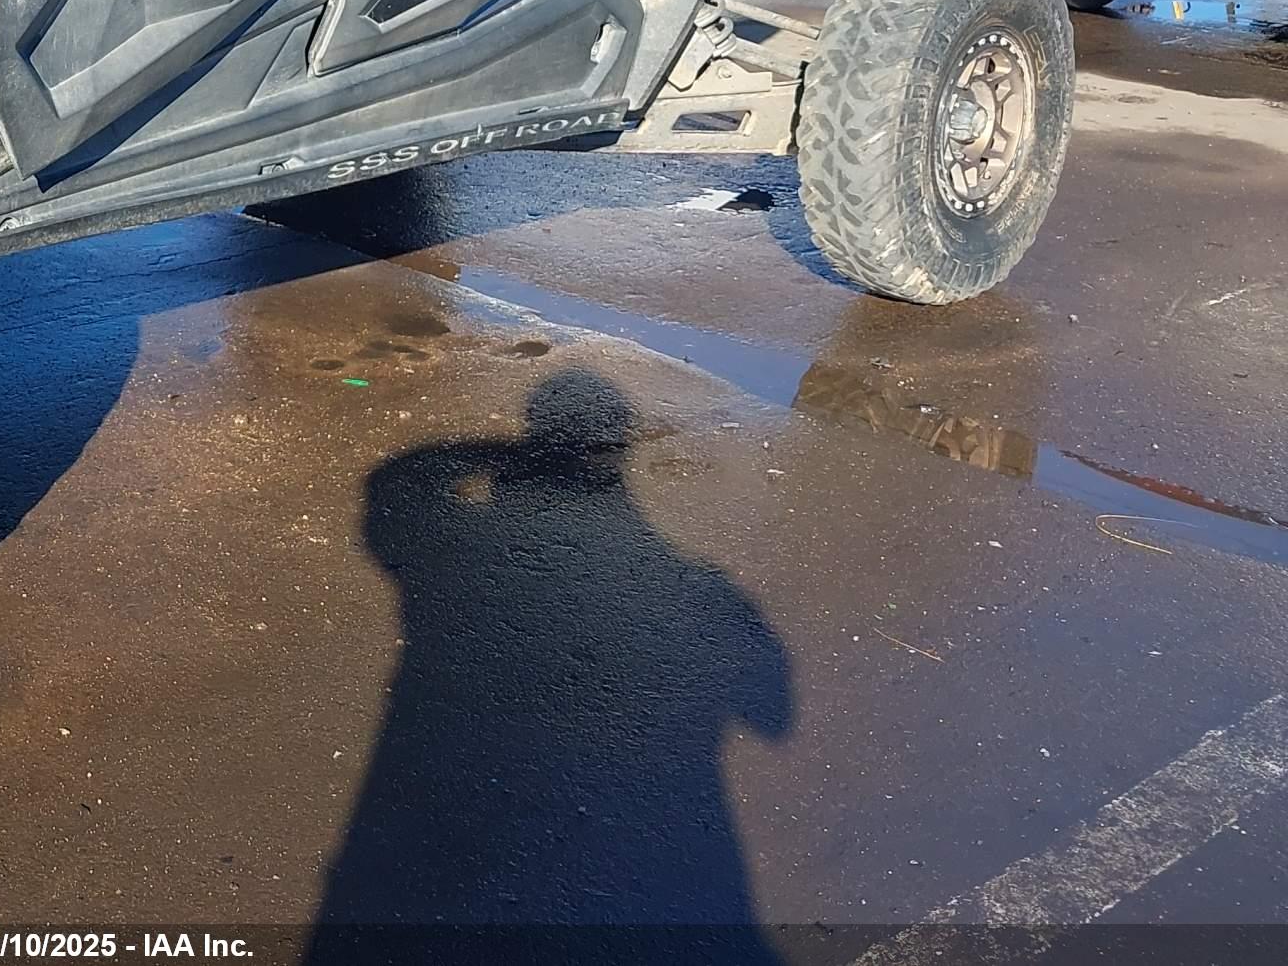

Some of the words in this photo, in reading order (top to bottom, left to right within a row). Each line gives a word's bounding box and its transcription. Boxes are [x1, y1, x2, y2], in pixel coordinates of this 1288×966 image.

[327, 145, 420, 180] SSS
[430, 129, 507, 155] OFF
[515, 111, 624, 138] ROAD
